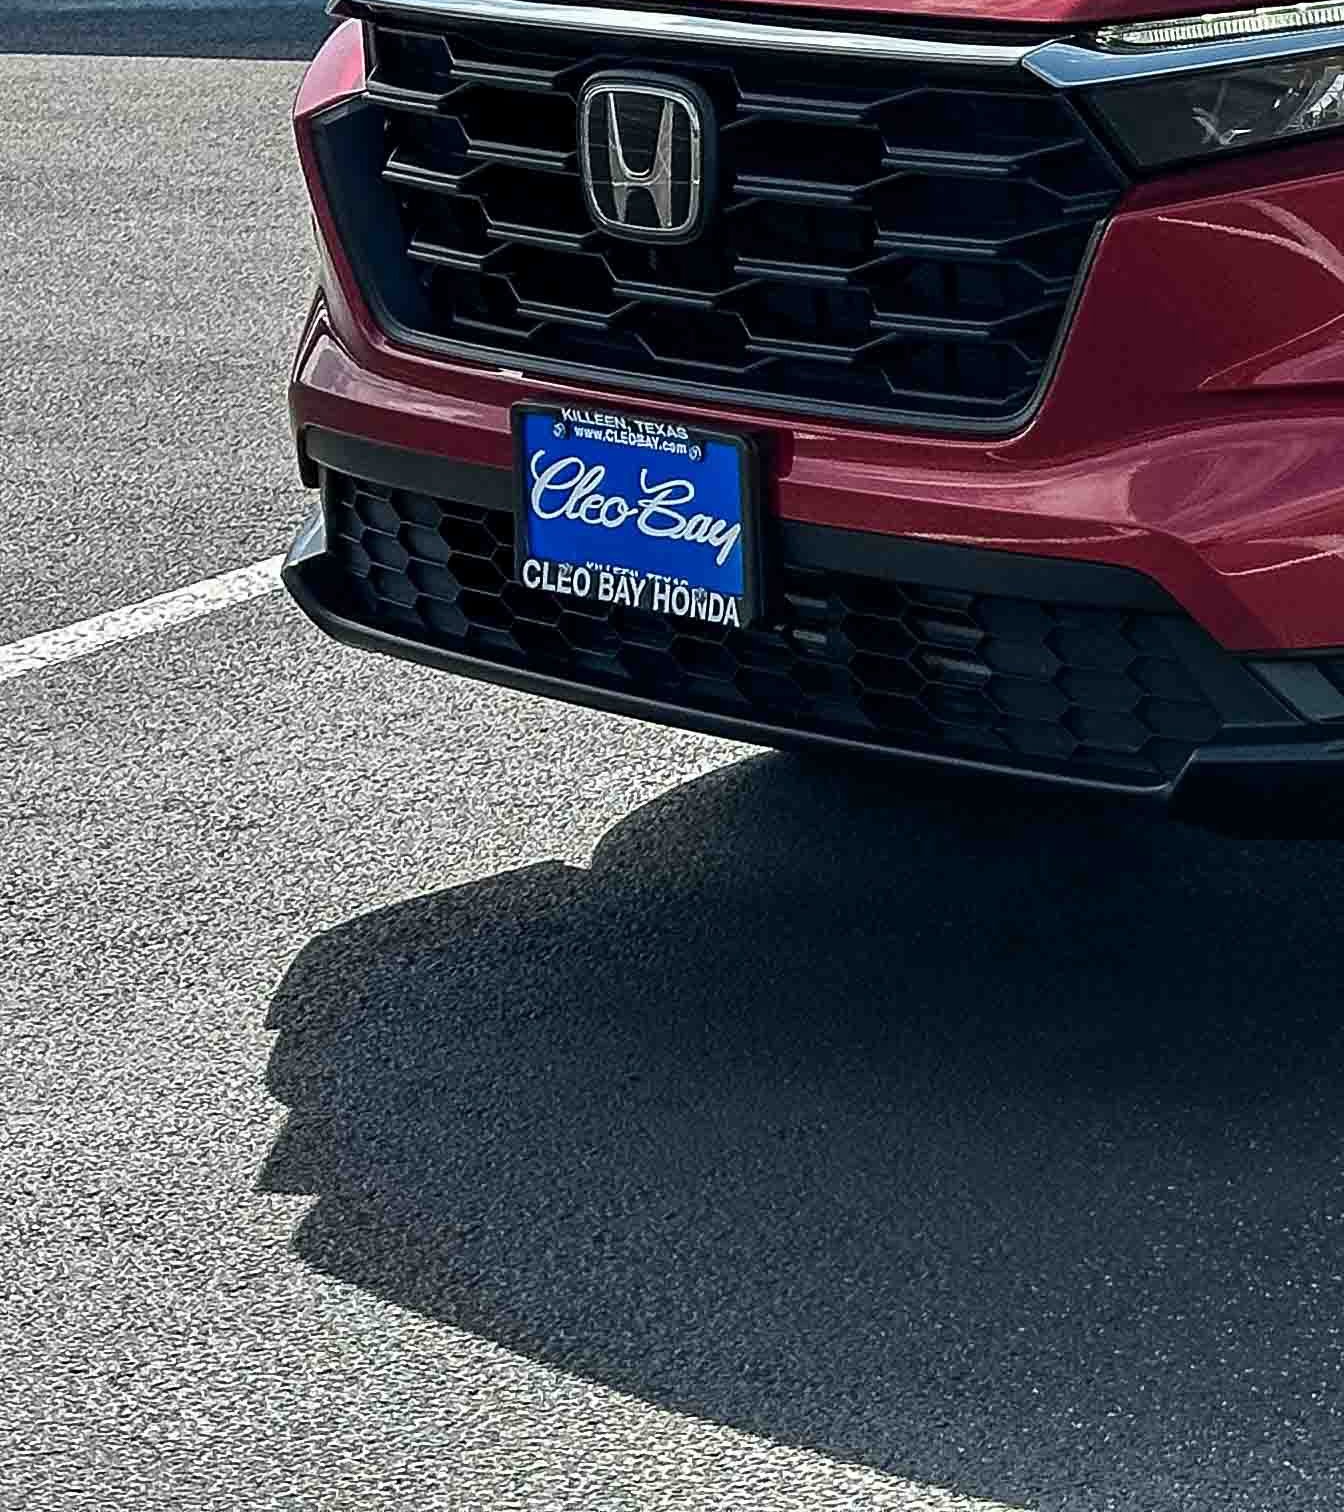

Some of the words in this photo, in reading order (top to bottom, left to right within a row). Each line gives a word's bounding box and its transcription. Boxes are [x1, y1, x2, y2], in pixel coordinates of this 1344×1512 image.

[561, 408, 632, 432] KILLEEN,
[634, 420, 689, 439] TEXAS
[574, 425, 688, 454] www.CLEOBAY.com
[531, 450, 638, 528] Cleo
[637, 468, 742, 566] Bay
[522, 559, 591, 597] CLEO
[598, 571, 646, 608] BAY
[652, 583, 740, 628] HONDA
